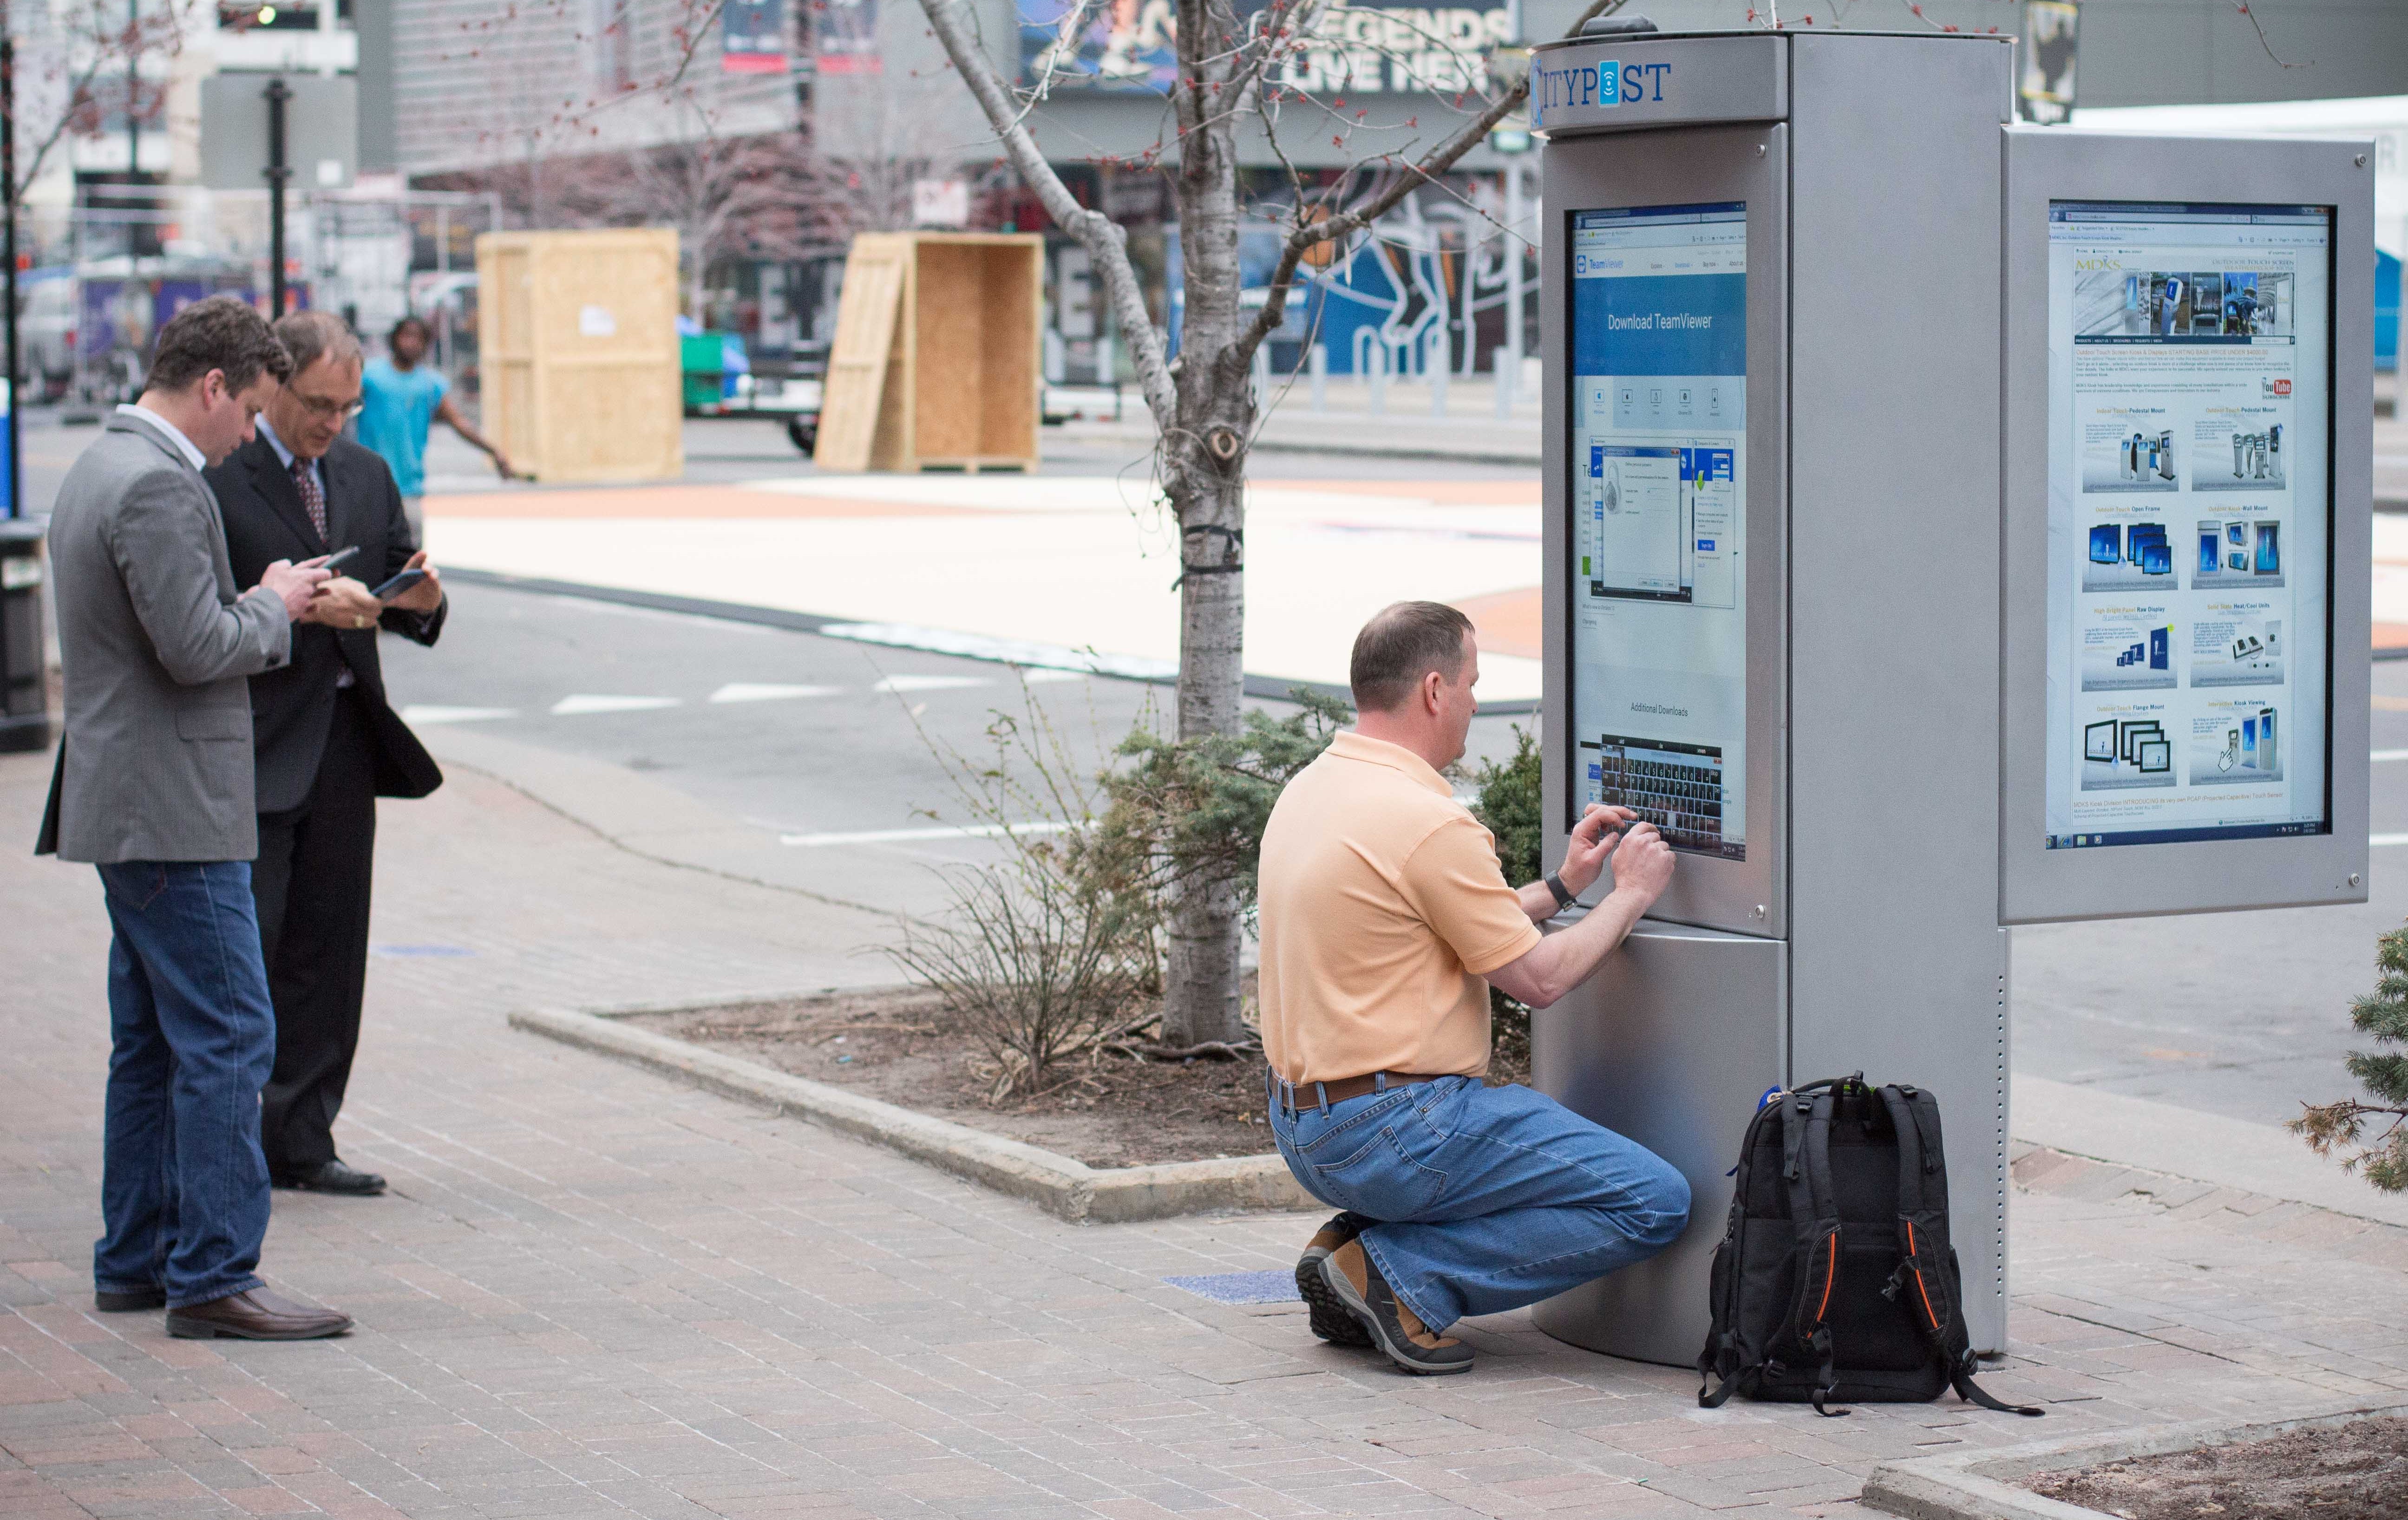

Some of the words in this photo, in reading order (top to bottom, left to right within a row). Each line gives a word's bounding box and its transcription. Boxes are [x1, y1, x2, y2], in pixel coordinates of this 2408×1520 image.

[1590, 259, 1623, 269] TeamViewer
[2076, 259, 2121, 270] MDKS
[1609, 313, 1652, 330] Download
[1655, 313, 1712, 330] TeamViewer
[1631, 702, 1657, 713] Additional
[1658, 705, 1688, 717] Downloads
